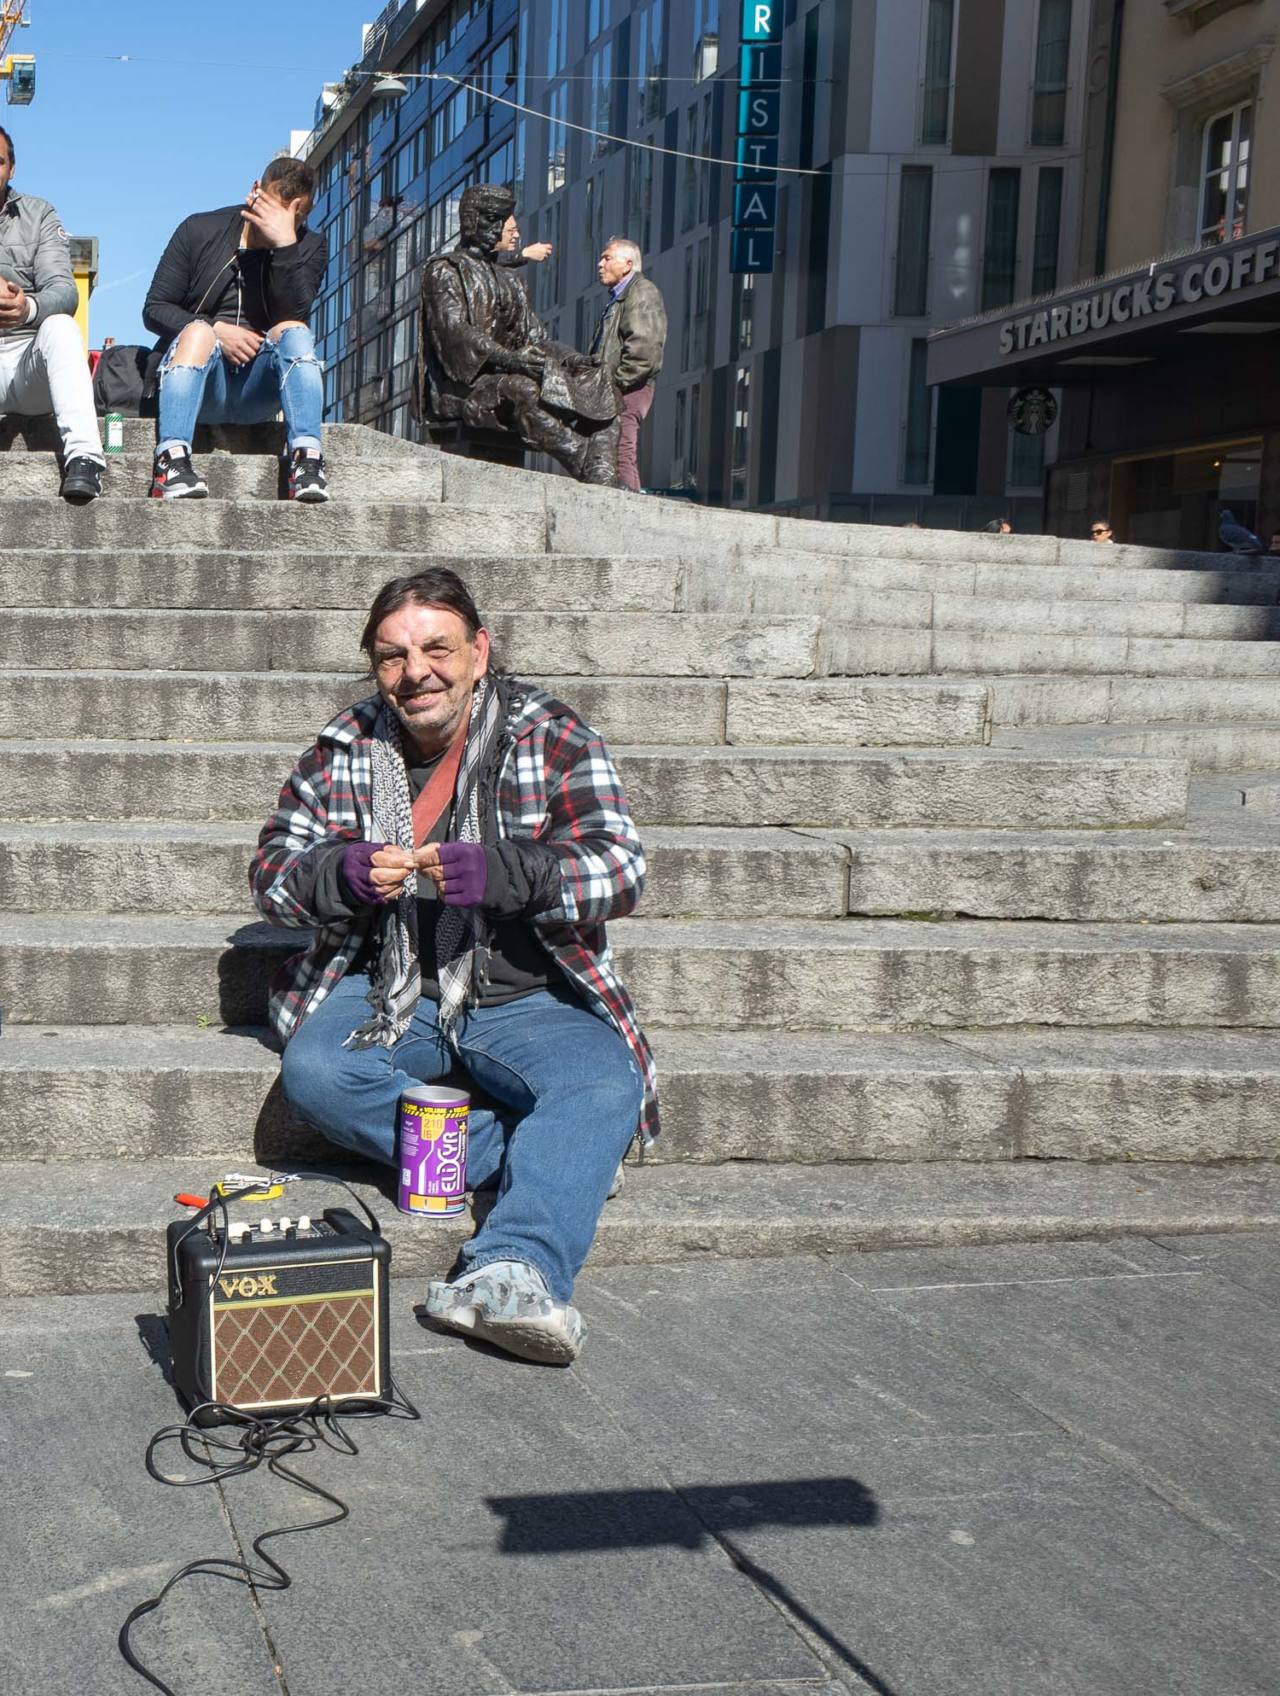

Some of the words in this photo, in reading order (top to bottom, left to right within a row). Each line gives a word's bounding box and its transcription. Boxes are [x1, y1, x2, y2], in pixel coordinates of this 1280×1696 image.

[999, 273, 1176, 355] STARBUCKS
[1181, 240, 1280, 304] COFF
[218, 1274, 278, 1298] VOX
